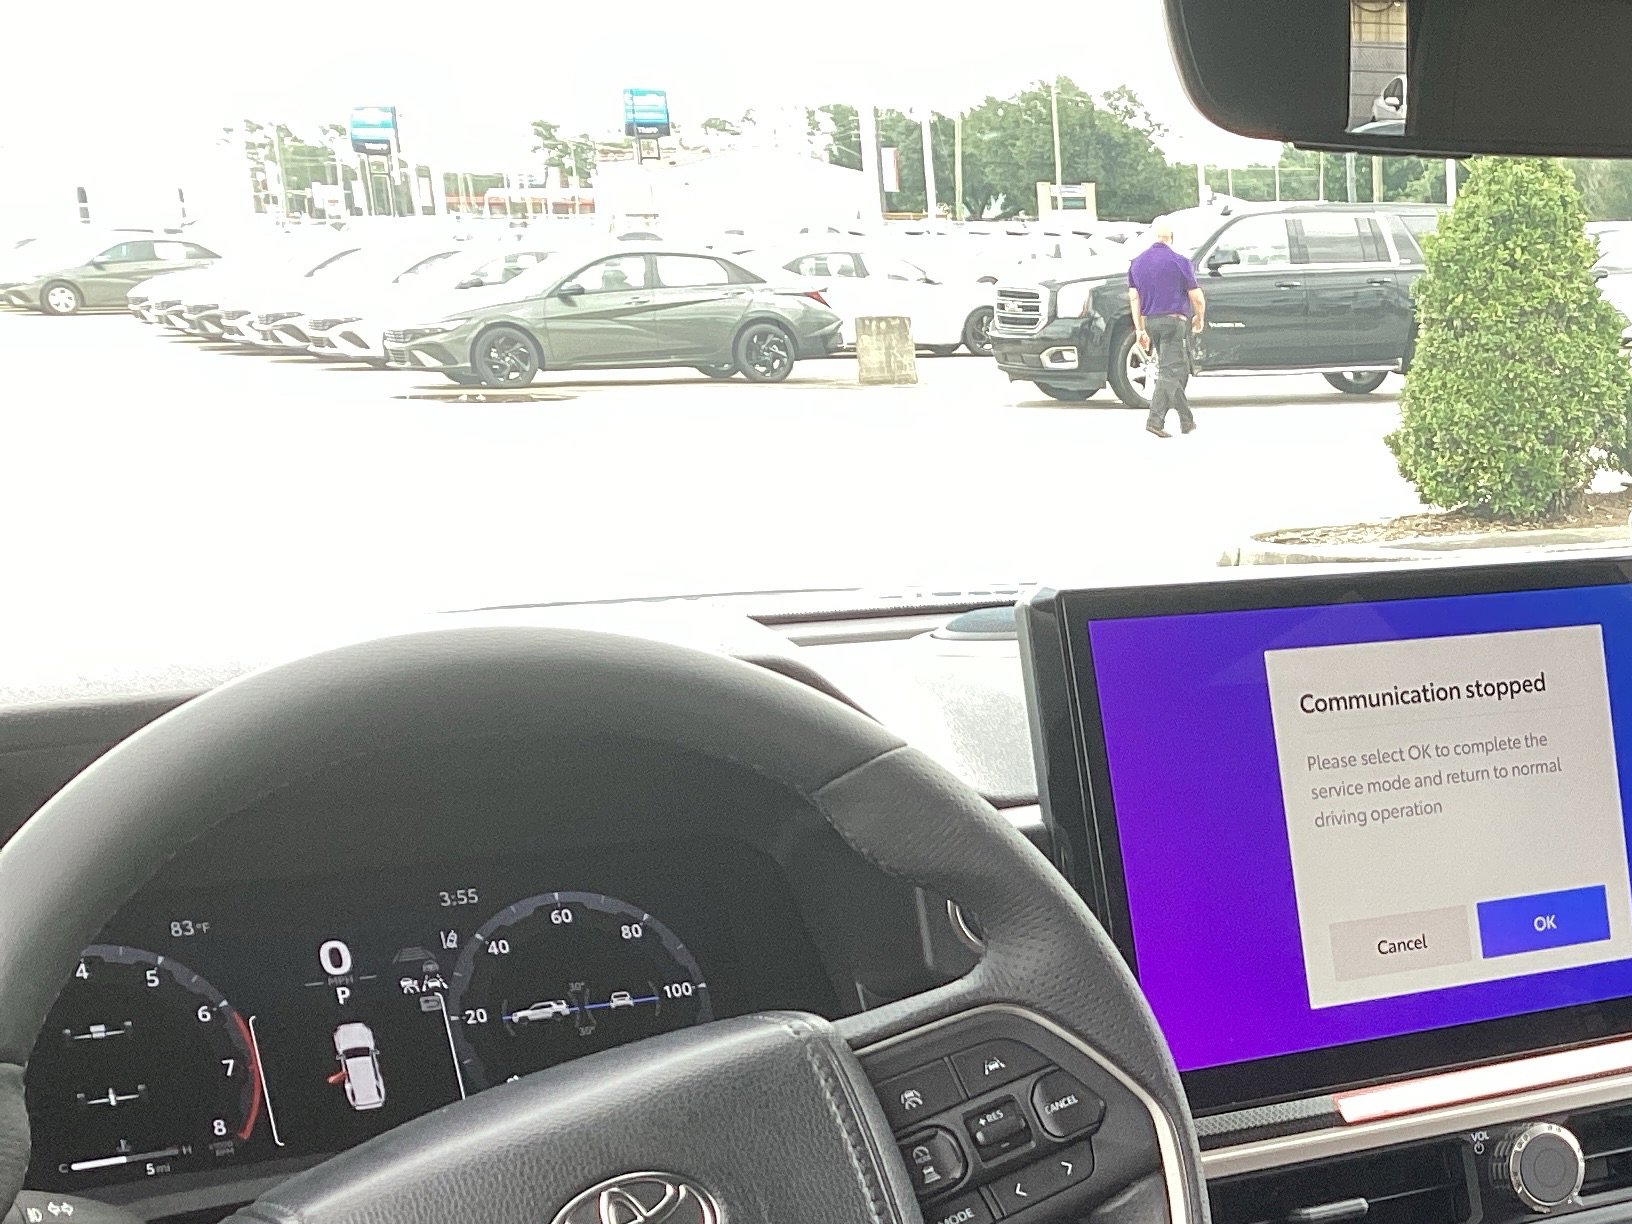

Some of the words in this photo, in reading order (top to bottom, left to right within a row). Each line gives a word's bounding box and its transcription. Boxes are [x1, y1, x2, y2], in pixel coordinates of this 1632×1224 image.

[1300, 682, 1461, 714] Communication
[1465, 671, 1547, 701] stopped
[1306, 754, 1357, 772] Please
[1361, 747, 1406, 766] select
[1407, 743, 1432, 760] OK
[1435, 742, 1450, 758] to
[1453, 734, 1522, 757] complete
[1524, 731, 1548, 748] the
[1310, 780, 1364, 800] service
[1366, 774, 1411, 793] mode
[1414, 769, 1443, 788] and
[1446, 767, 1490, 785] return
[1493, 764, 1509, 779] to
[1511, 756, 1562, 776] normal
[1314, 810, 1368, 828] driving
[1370, 800, 1443, 823] operation
[439, 888, 479, 907] 3:55
[550, 908, 573, 925] 60
[1533, 914, 1558, 932] OK
[620, 923, 643, 940] 80
[487, 939, 511, 956] 40
[1377, 933, 1428, 955] Cancel
[319, 939, 352, 976] 0
[75, 963, 90, 980] 4
[146, 969, 160, 987] 5
[336, 986, 350, 1005] P
[663, 981, 693, 999] 100
[197, 1005, 212, 1022] 6
[464, 1008, 488, 1025] 20
[221, 1059, 235, 1077] 7
[1044, 1094, 1079, 1115] CANCEL
[213, 1119, 227, 1136] 8
[1470, 1131, 1490, 1142] VOL
